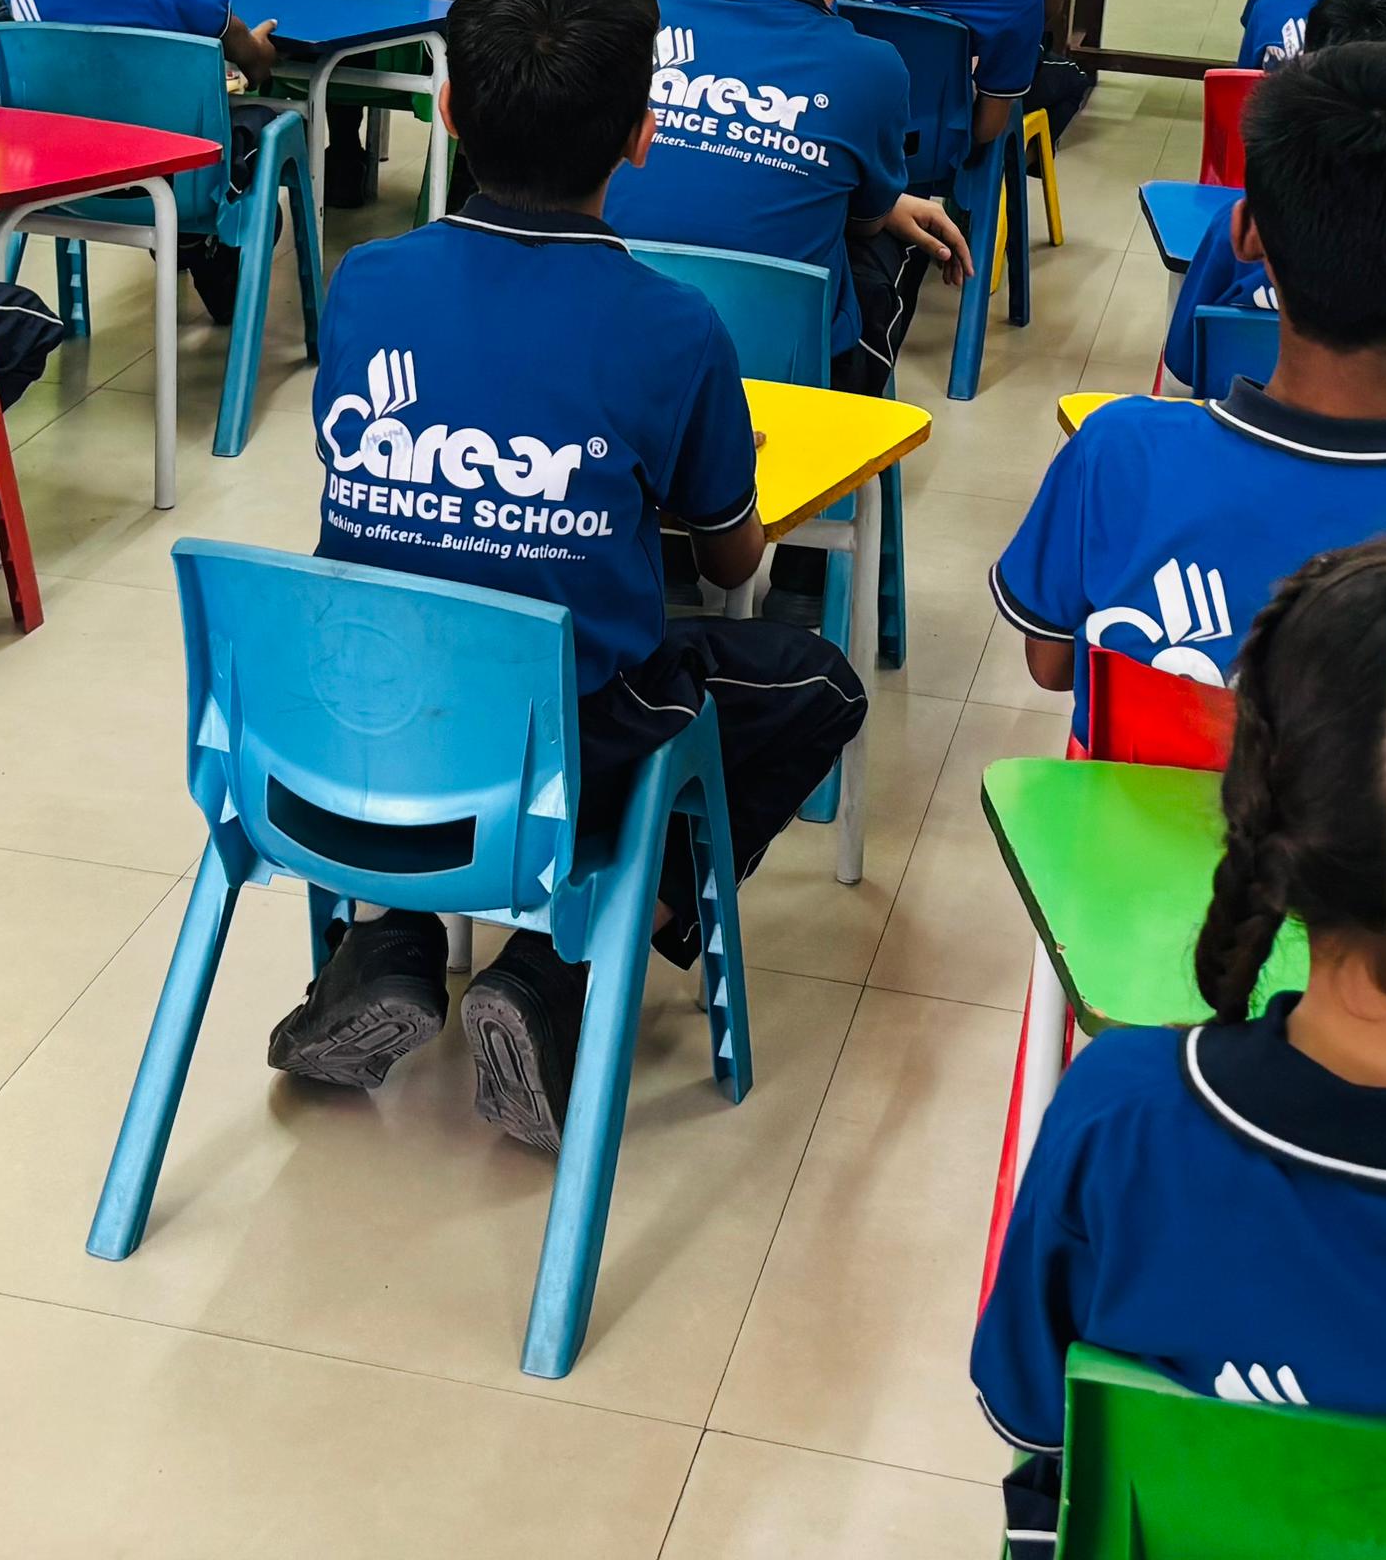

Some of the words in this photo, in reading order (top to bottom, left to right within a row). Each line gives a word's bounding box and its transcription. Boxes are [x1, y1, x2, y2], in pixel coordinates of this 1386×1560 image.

[649, 108, 719, 136] ENCE
[726, 121, 830, 167] SCHOOL
[328, 509, 362, 538] Making
[329, 472, 462, 524] DEFENCE
[473, 499, 613, 537] SCHOOL
